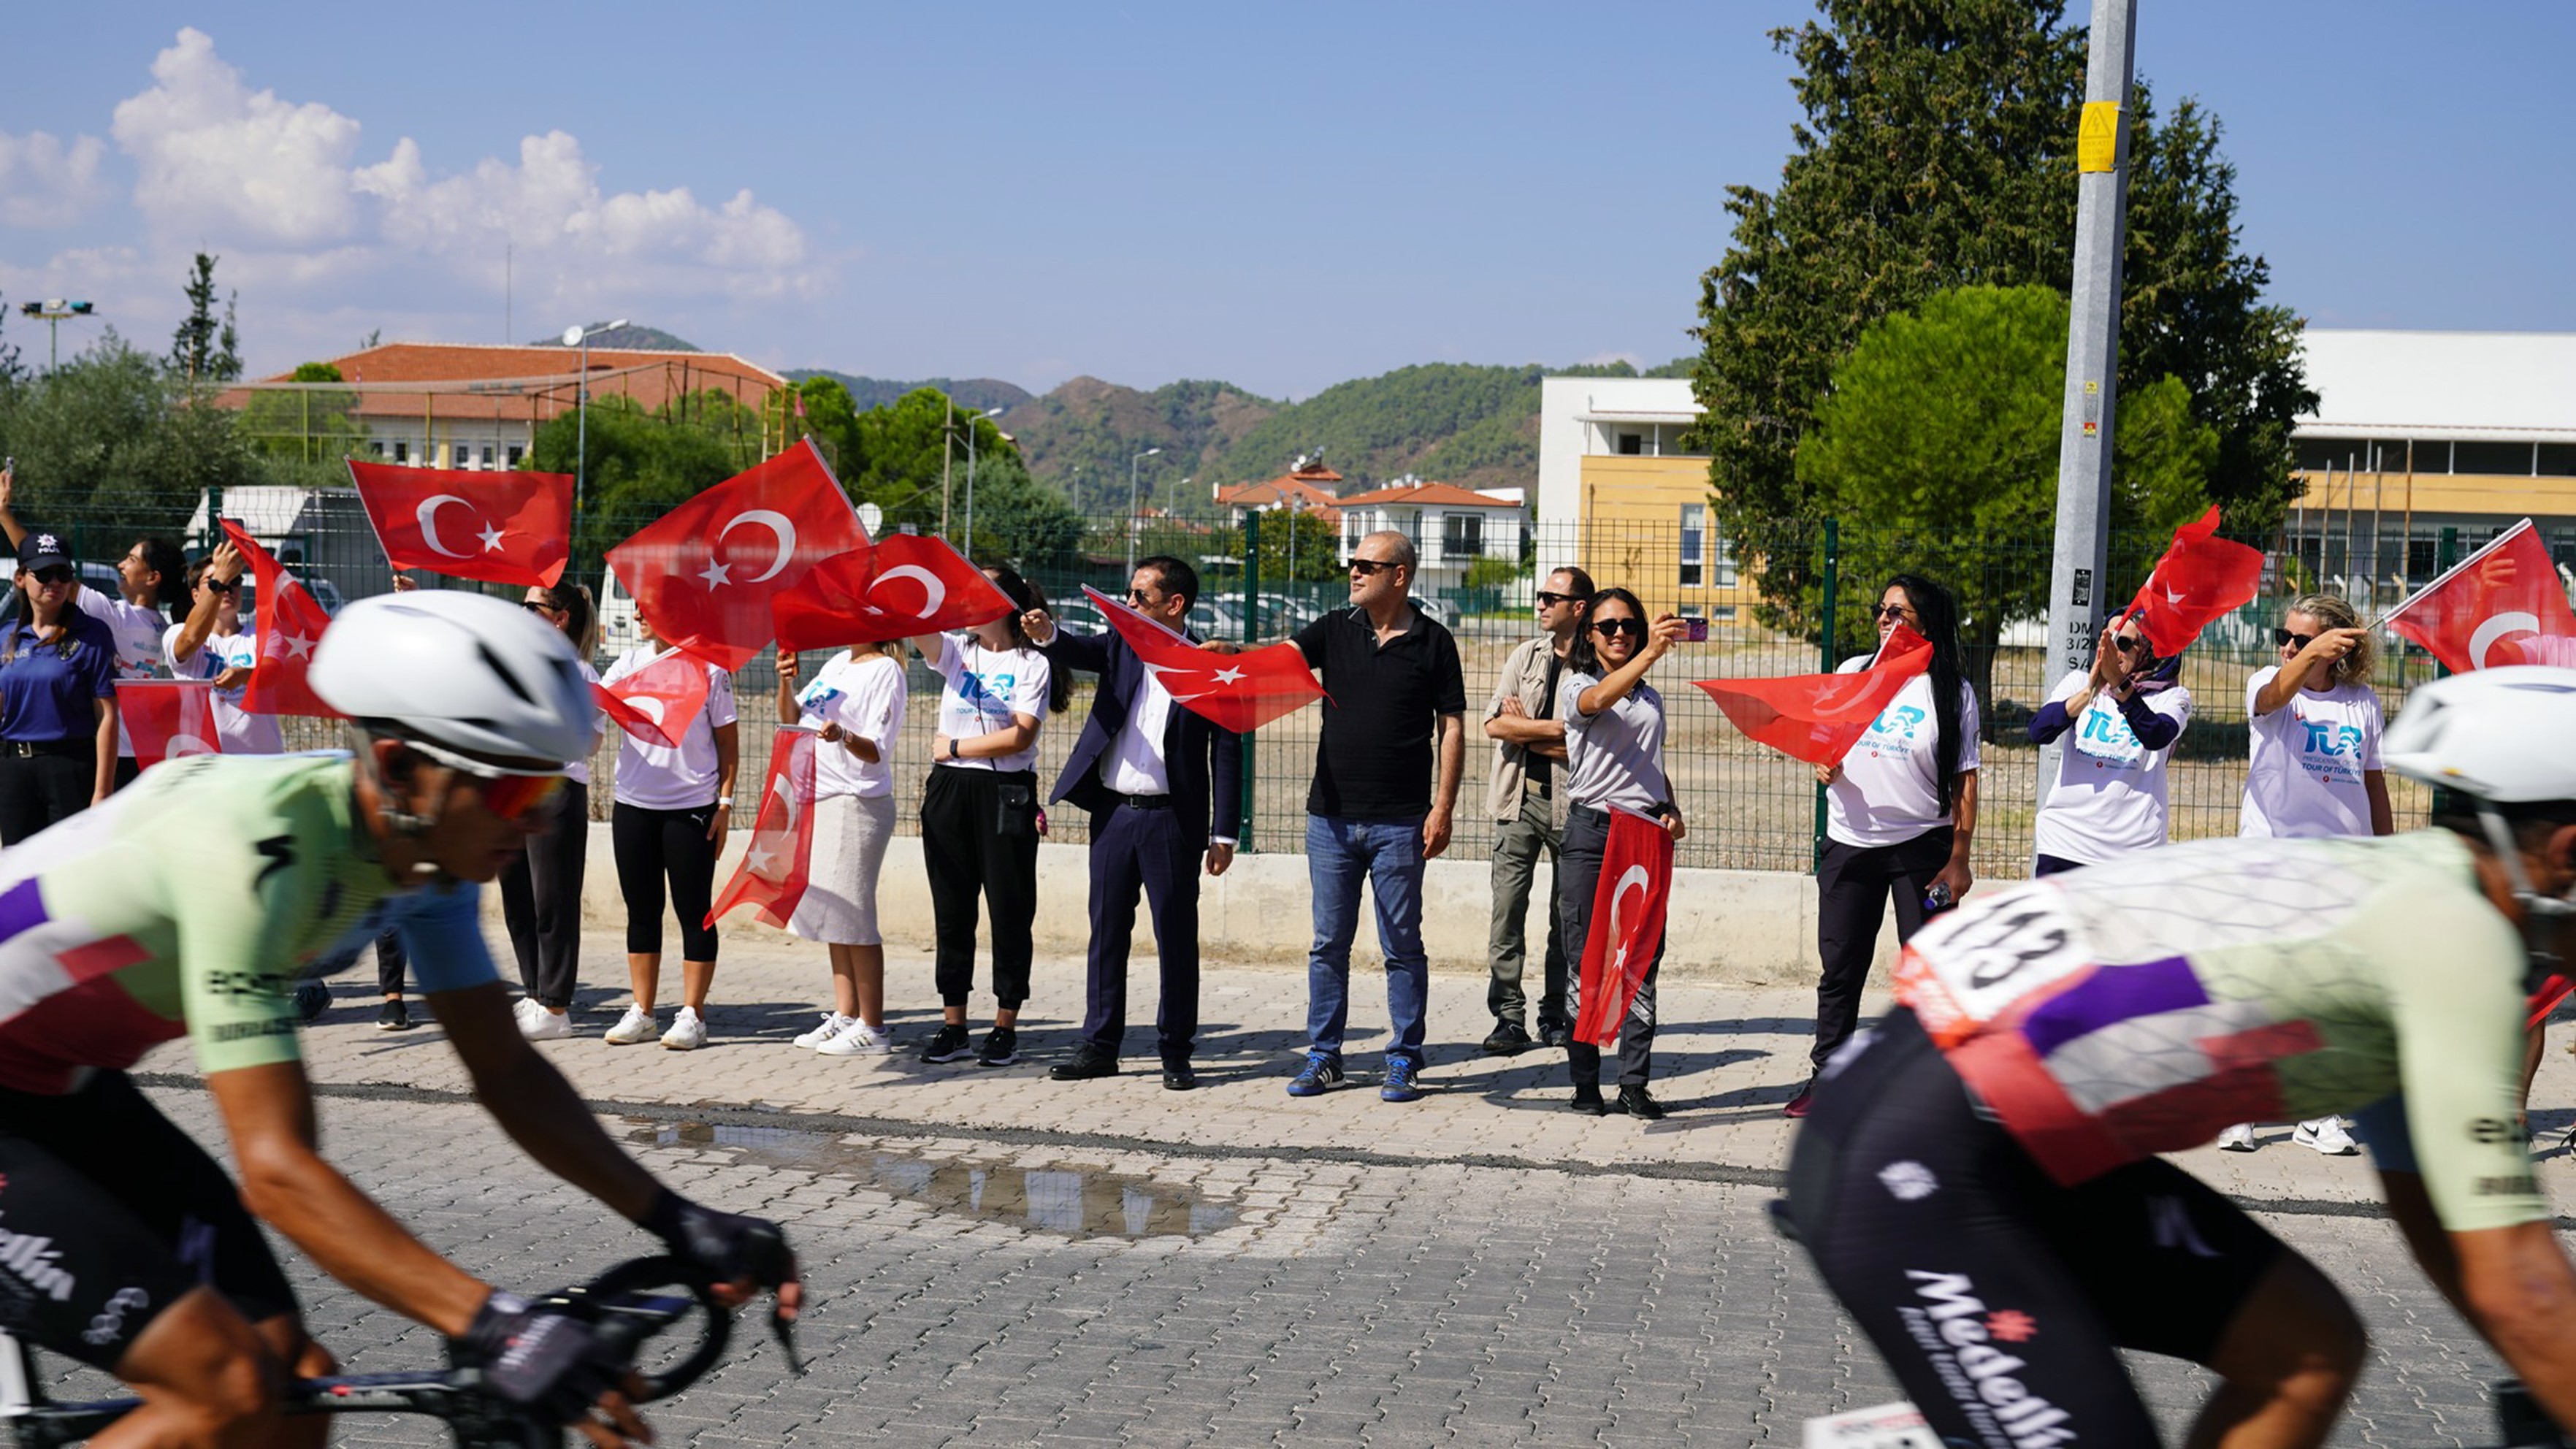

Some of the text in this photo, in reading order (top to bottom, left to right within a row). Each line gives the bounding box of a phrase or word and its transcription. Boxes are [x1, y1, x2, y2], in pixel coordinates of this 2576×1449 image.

[2069, 622, 2093, 635] DM
[2301, 721, 2362, 760] TUR
[2302, 762, 2323, 771] TOUR
[2323, 765, 2333, 773] OF
[1903, 1268, 2080, 1449] Medellí
